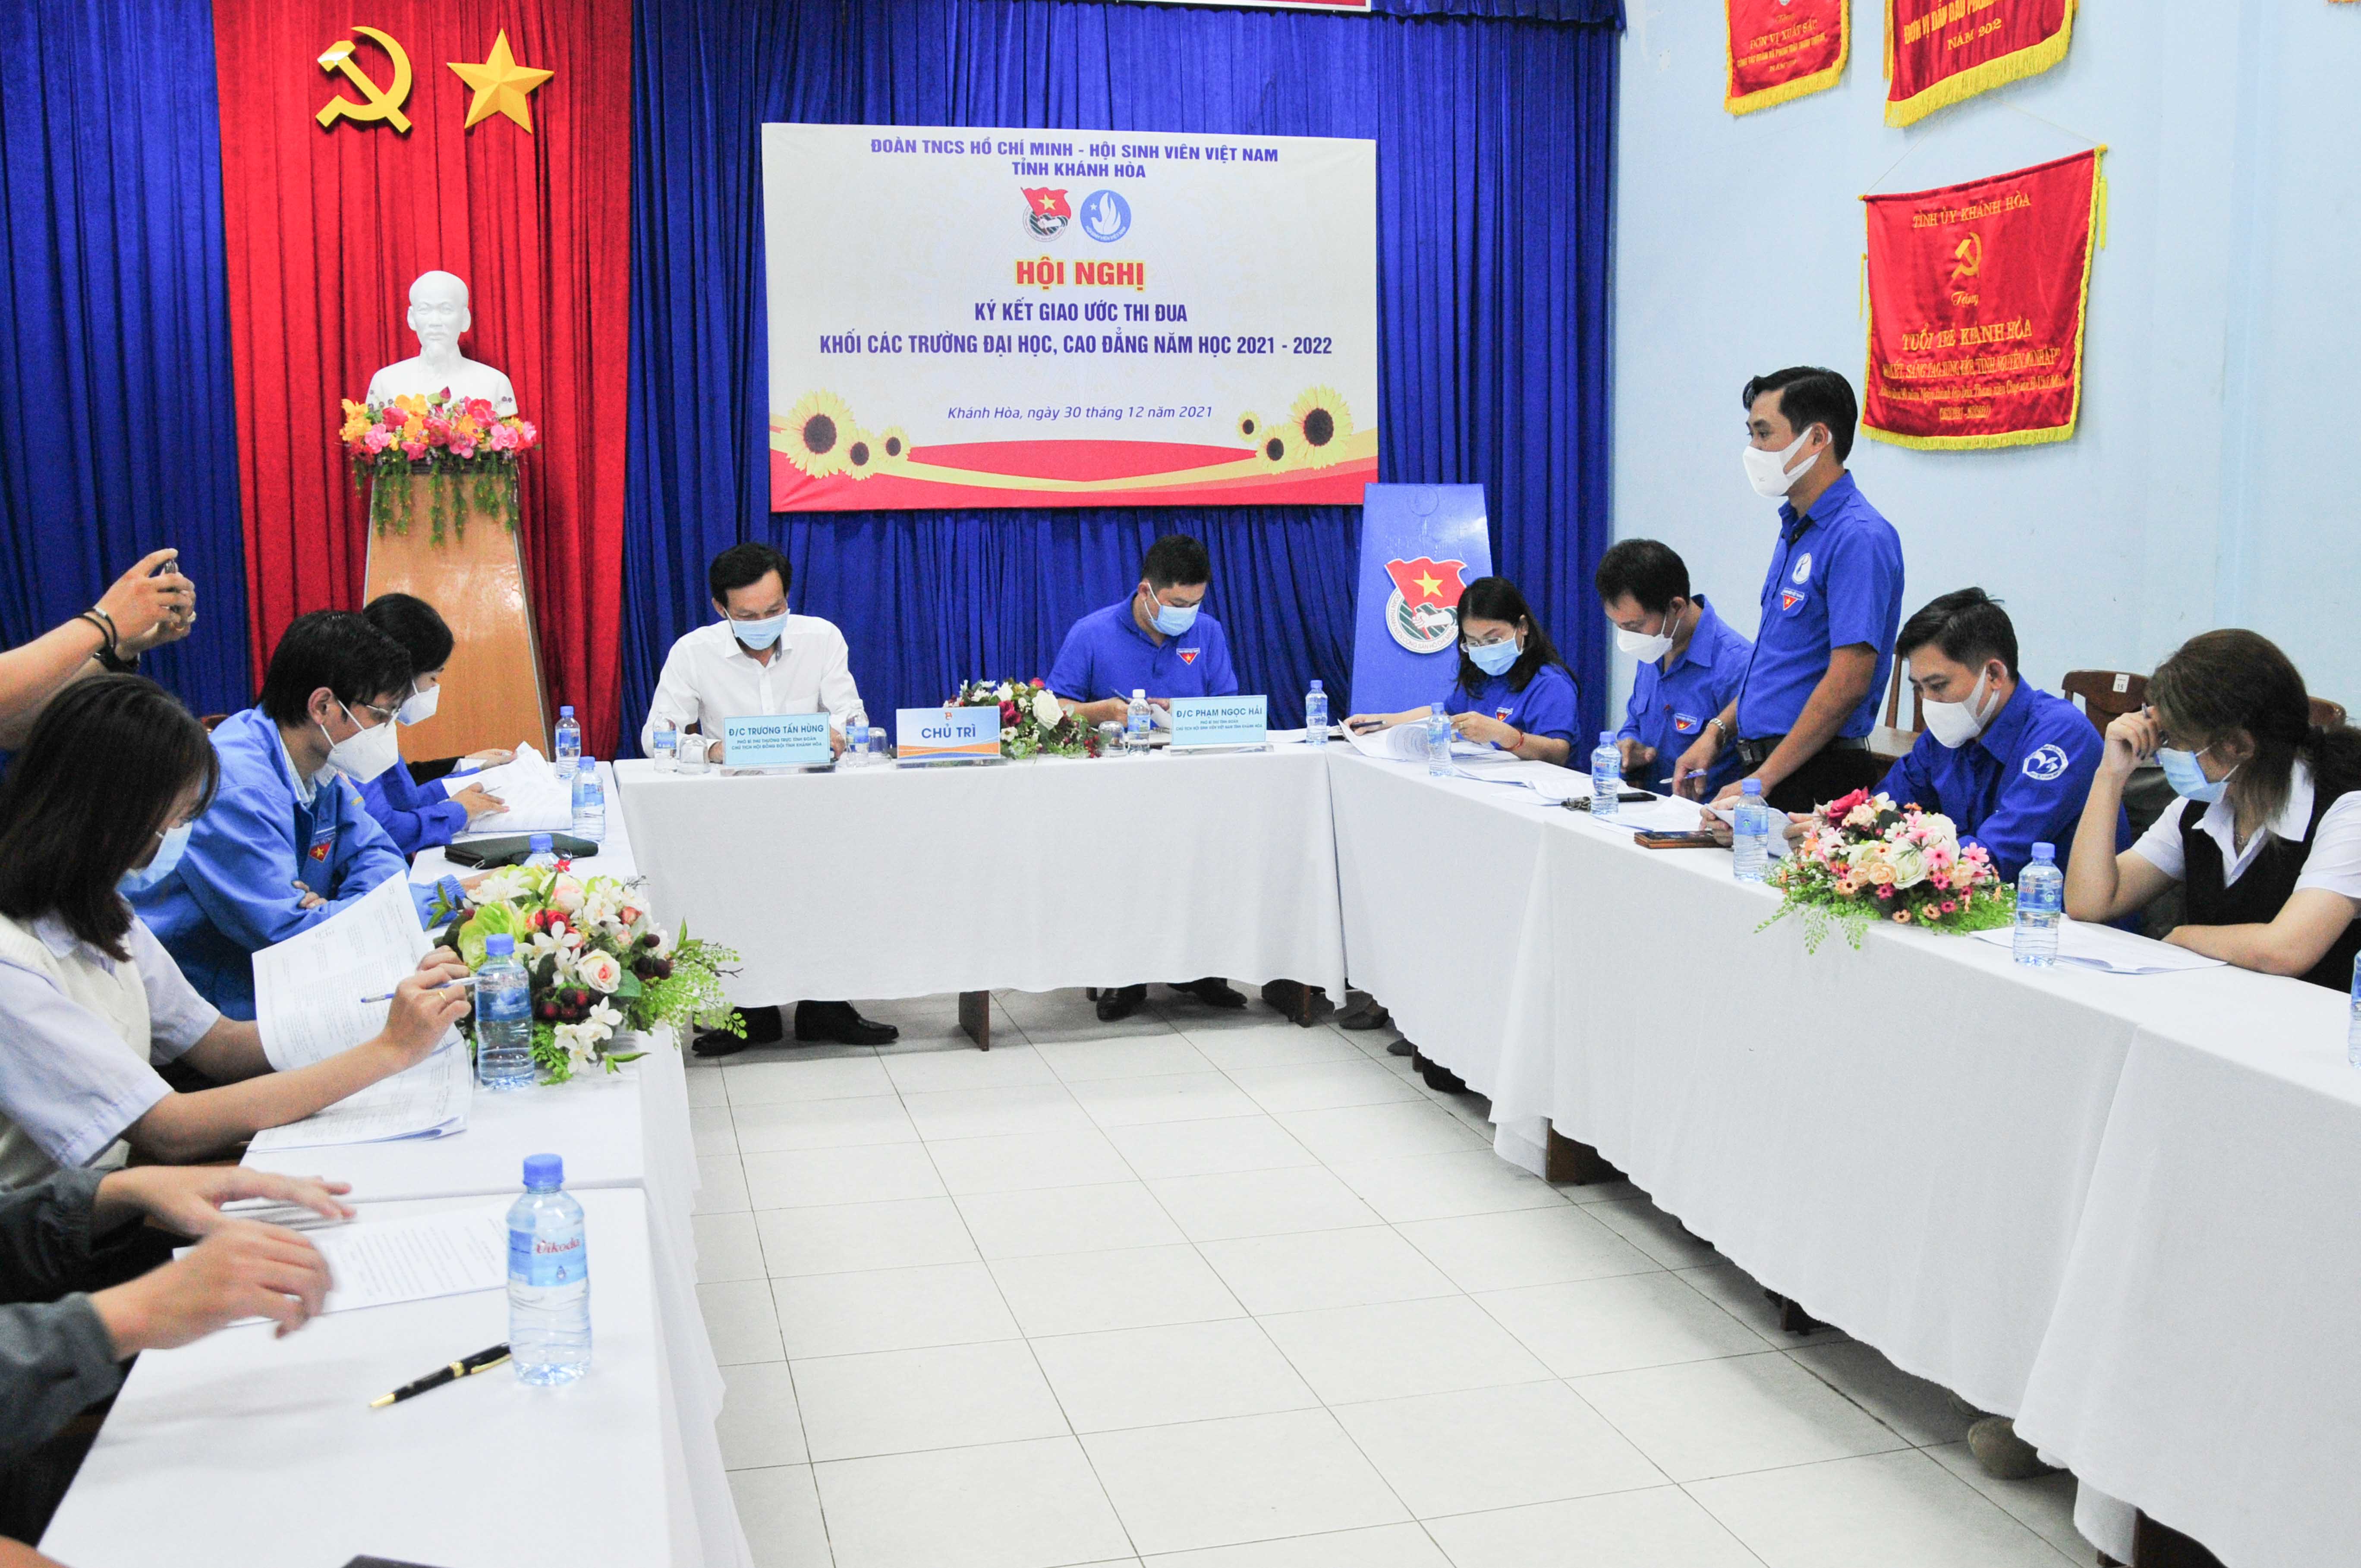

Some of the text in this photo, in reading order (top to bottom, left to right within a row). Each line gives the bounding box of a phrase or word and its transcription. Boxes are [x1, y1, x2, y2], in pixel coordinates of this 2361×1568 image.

[1769, 32, 1779, 45] VỊ
[871, 137, 916, 153] ĐOÀN
[922, 140, 965, 154] TNCS
[970, 137, 992, 155] HỒ
[998, 139, 1024, 155] CHÍ
[1030, 142, 1073, 156] MINH
[1089, 141, 1116, 160] HỘI
[1121, 145, 1159, 159] SINH
[1165, 144, 1200, 160] VIÊN
[1205, 145, 1237, 164] VIỆT
[1243, 148, 1278, 162] NAM
[1012, 157, 1146, 178] TỈNH KHÁNH HÒA
[1960, 200, 2002, 221] KHÁNH
[2005, 190, 2031, 211] HÒA
[1017, 257, 1143, 290] HỘI NGHỊ
[975, 297, 1187, 322] KÝ KẾT GIAO ƯỚC THI ĐUA
[820, 328, 861, 353] KHỐI
[868, 331, 902, 353] CÁC
[908, 331, 977, 353] TRƯỜNG
[983, 335, 1011, 357] ĐẠI
[1018, 335, 1057, 357] HỌC,
[1064, 335, 1096, 353] CAO
[1102, 327, 1148, 353] ĐẲNG
[1154, 332, 1193, 353] NĂM
[1199, 336, 1231, 358] HỌC
[1237, 336, 1274, 354] 2021
[1293, 337, 1332, 354] 2022
[948, 406, 1212, 421] Khánh Hòa, ngày 30 tháng 12 năm 2021
[1177, 705, 1262, 718] Đ/C PHẠM NGỌC HẢI
[729, 722, 824, 737] Đ/C TRƯƠNG TẤN HÙNG
[921, 723, 976, 739] CHỦ TRÌ
